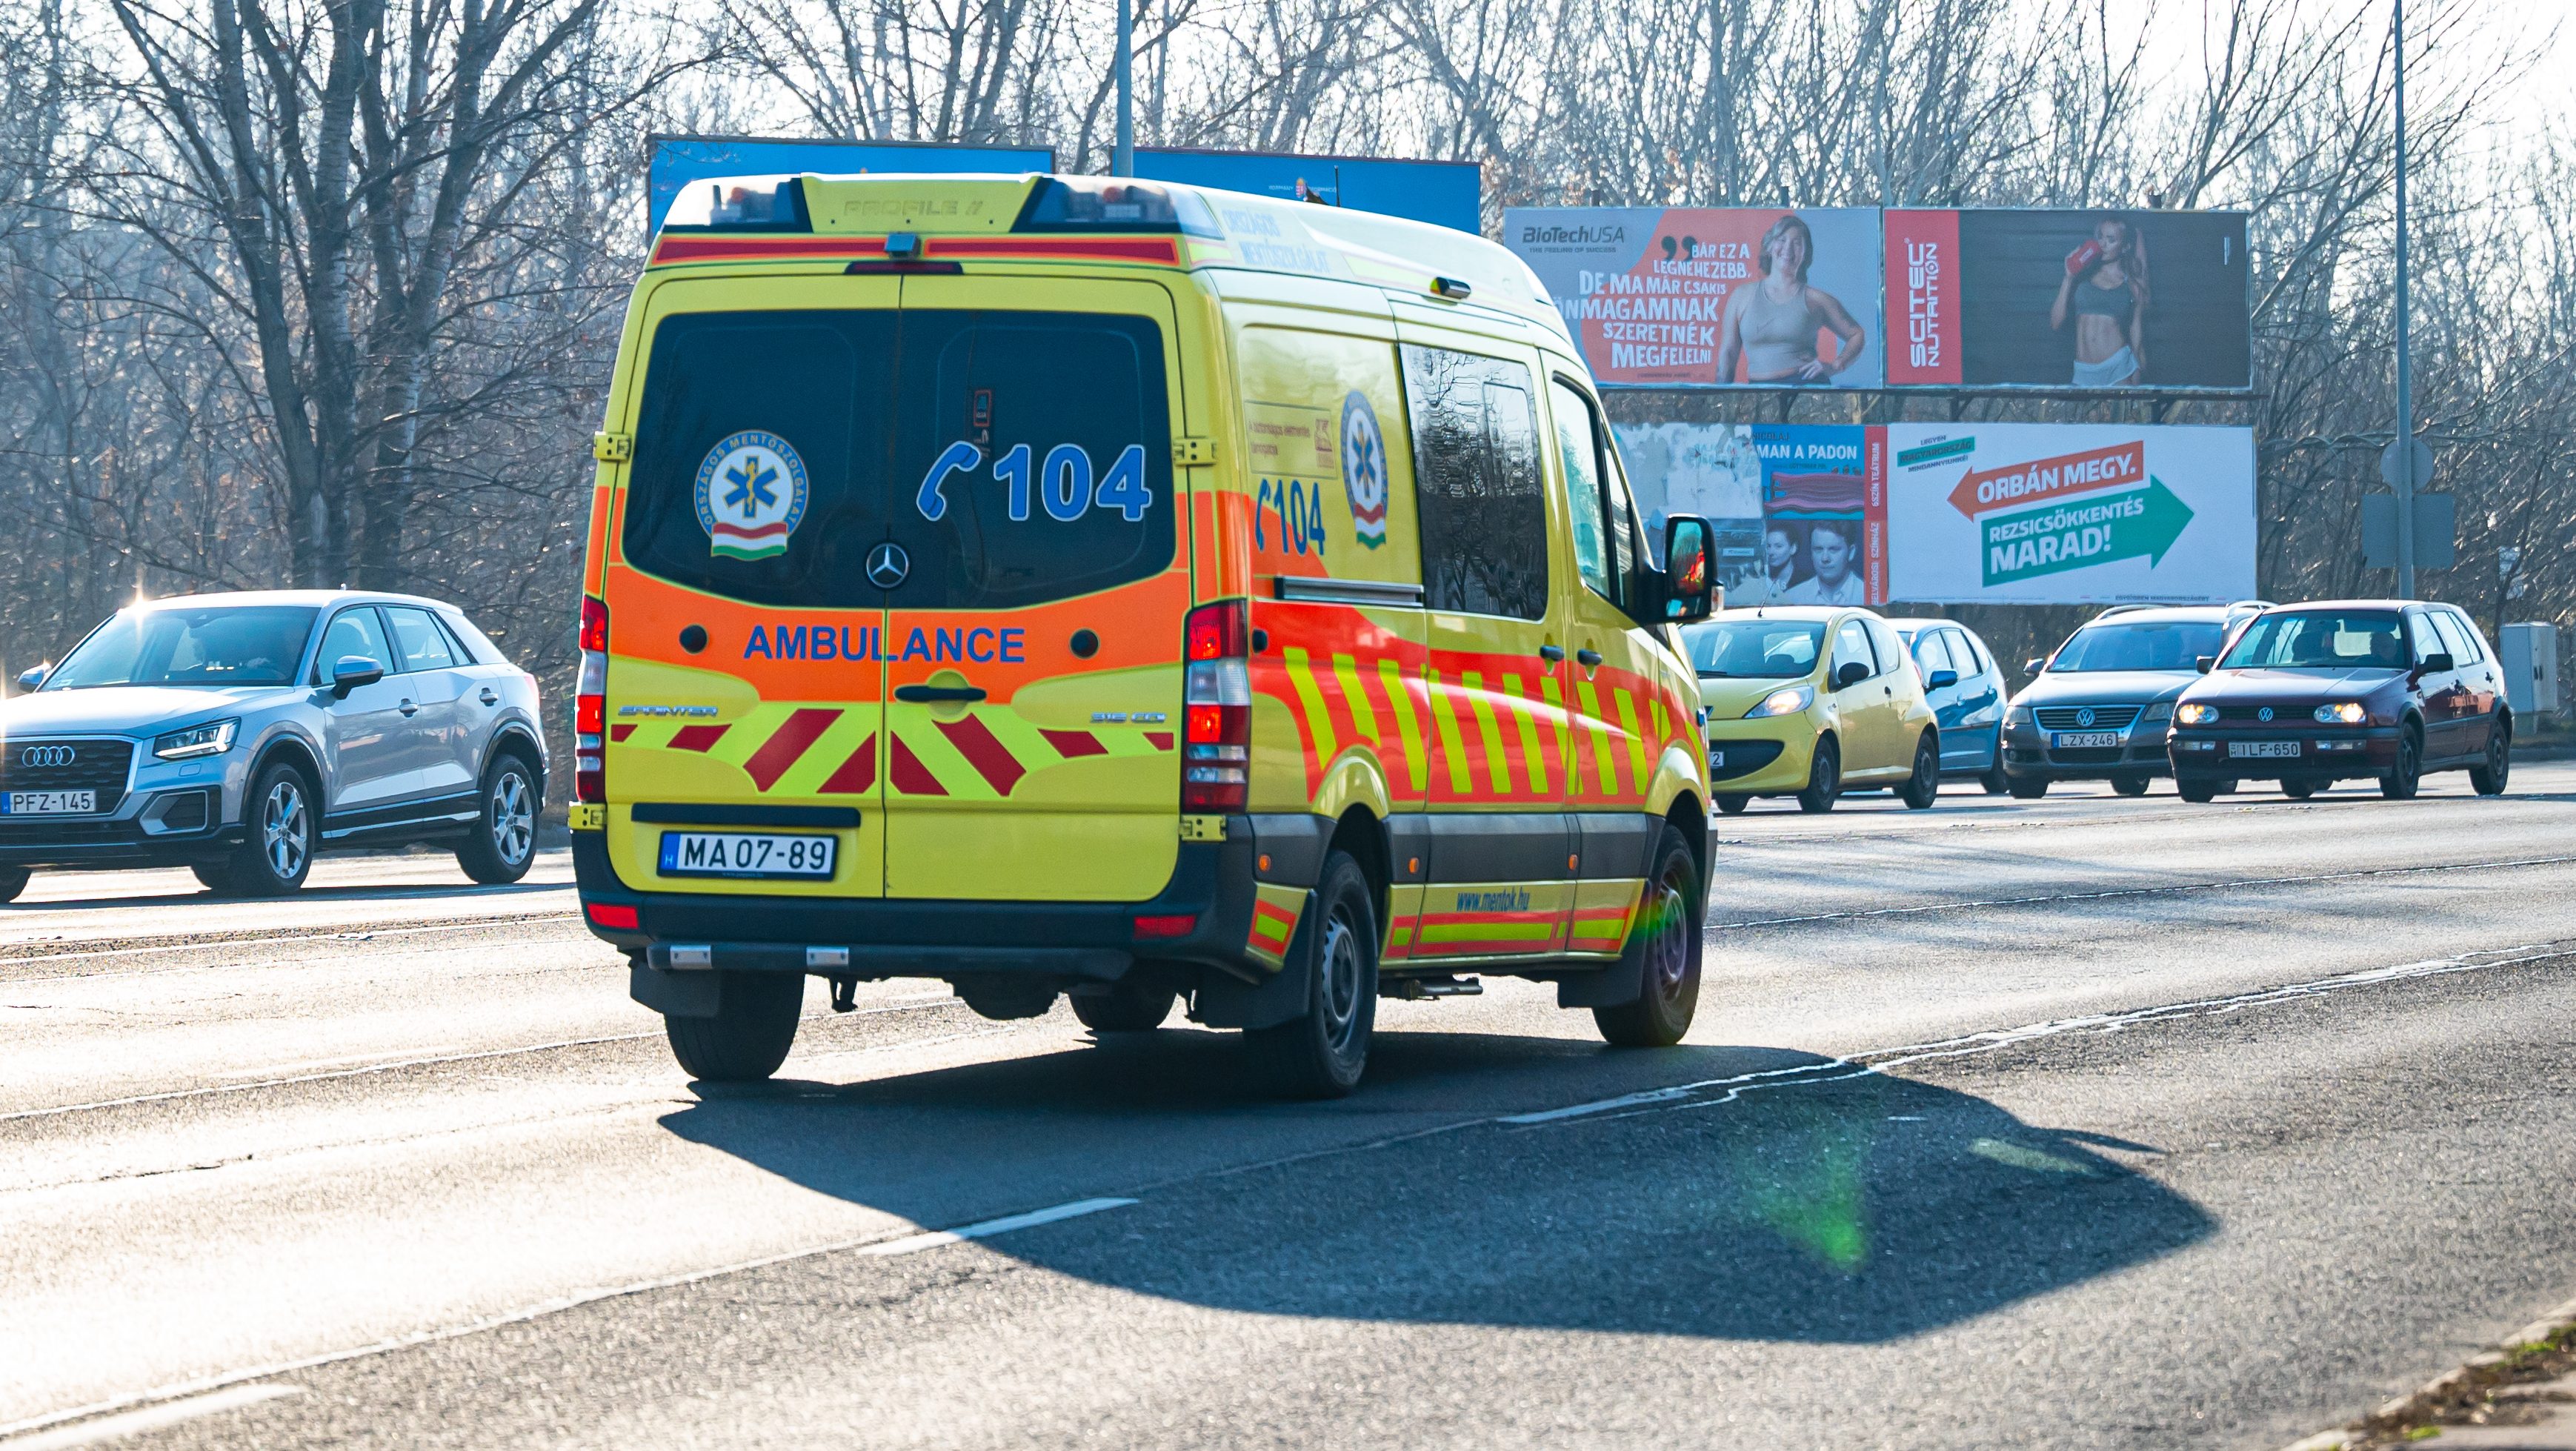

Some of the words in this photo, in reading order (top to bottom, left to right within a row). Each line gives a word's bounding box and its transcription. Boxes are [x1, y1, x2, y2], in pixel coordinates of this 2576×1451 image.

[1691, 243, 1717, 259] BÁR
[1720, 244, 1736, 259] EZ
[1739, 243, 1750, 259] A
[1579, 270, 1605, 295] DE
[1610, 273, 1644, 294] MA
[1646, 276, 1680, 294] MÁR
[1907, 243, 1926, 368] SCITEC
[1926, 242, 1940, 368] NUTRITION
[1602, 320, 1715, 347] SZERETNÉK
[1611, 342, 1711, 369] MEGFELELNI
[1794, 445, 1805, 459] A
[1808, 445, 1857, 459] PADON
[994, 443, 1151, 522] 104
[1977, 461, 2059, 504] ORBÁN
[2064, 453, 2136, 486] MEGY.
[1274, 479, 1326, 556] 104
[1989, 495, 2144, 542] REZSICSÖKKENTÉS
[1991, 525, 2111, 575] MARAD!
[744, 625, 1025, 663] AMBULANCE
[2060, 734, 2113, 747] LZX-246
[13, 793, 90, 811] PFZ-145
[685, 838, 727, 867] MA
[736, 840, 826, 869] 07-89
